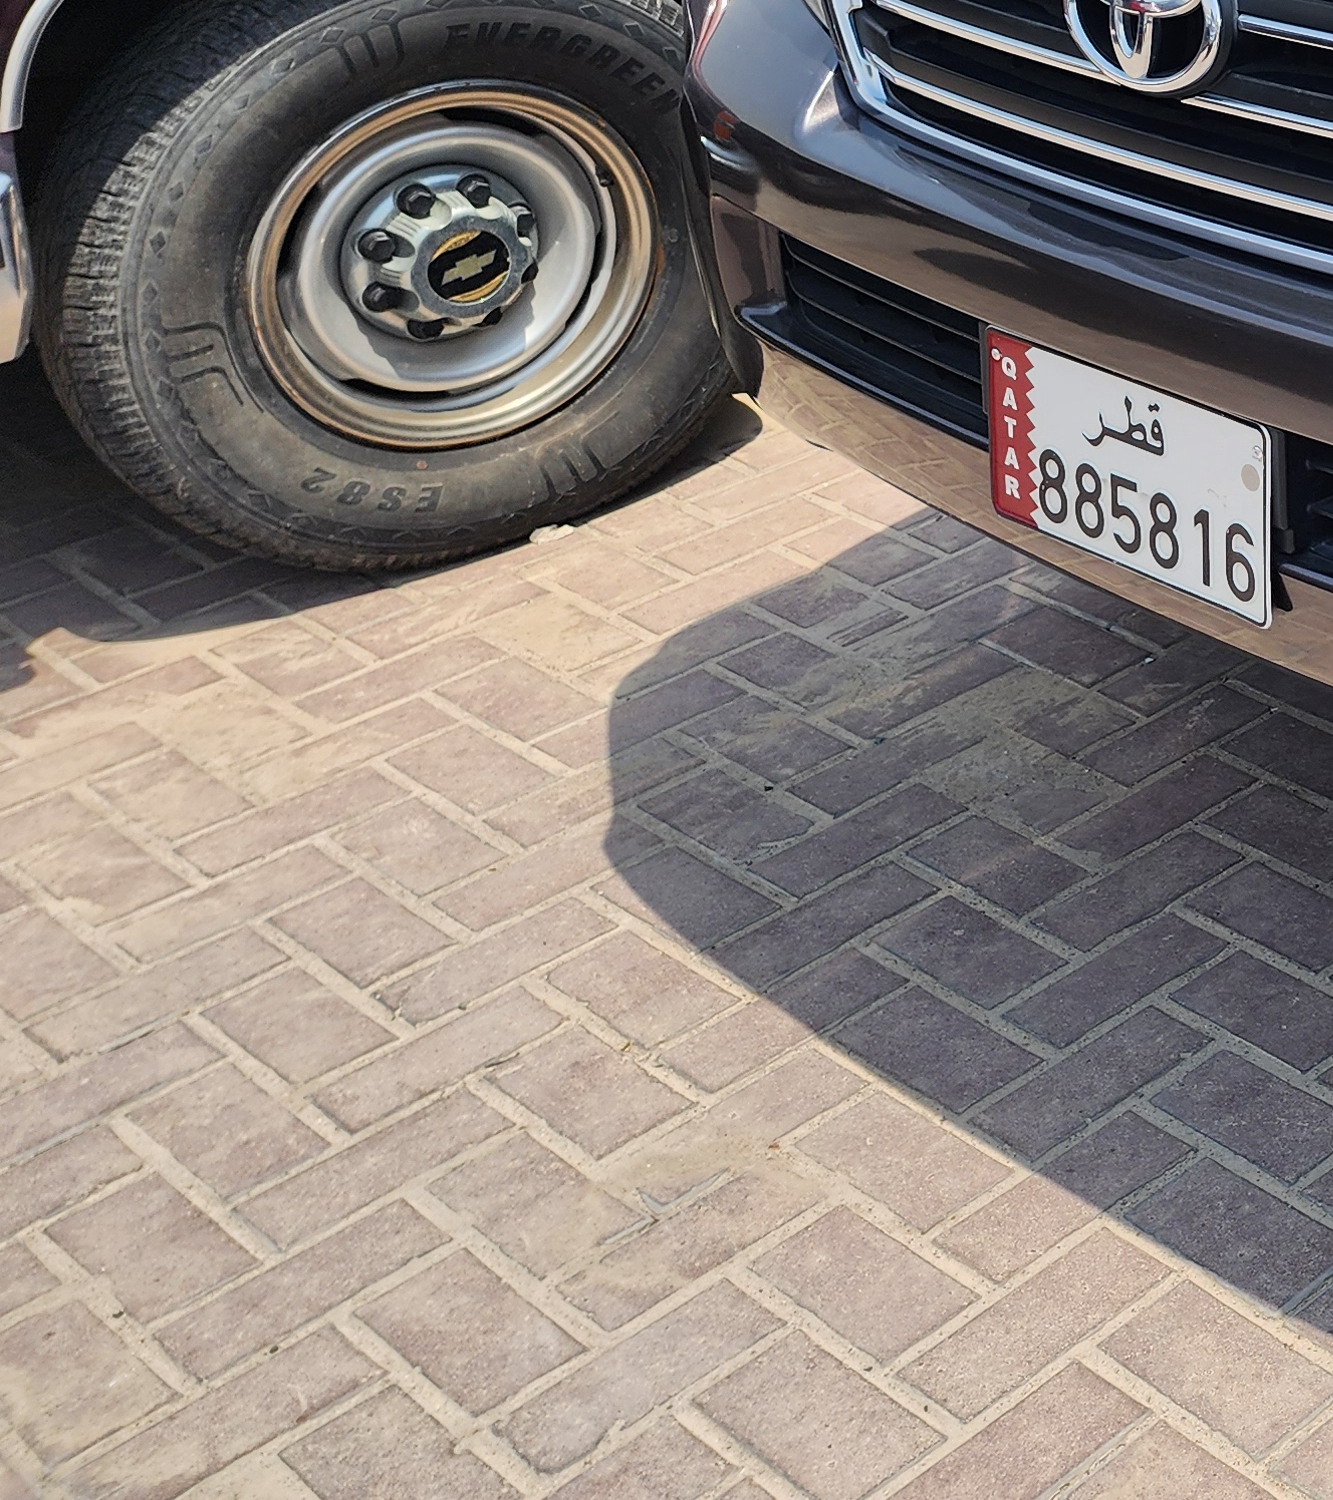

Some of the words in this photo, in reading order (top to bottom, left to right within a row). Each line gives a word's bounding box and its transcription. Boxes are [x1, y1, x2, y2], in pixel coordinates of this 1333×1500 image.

[1001, 356, 1021, 500] QATAR
[1081, 395, 1165, 457] قطر
[300, 466, 444, 513] ES82
[1038, 448, 1256, 603] 885816
